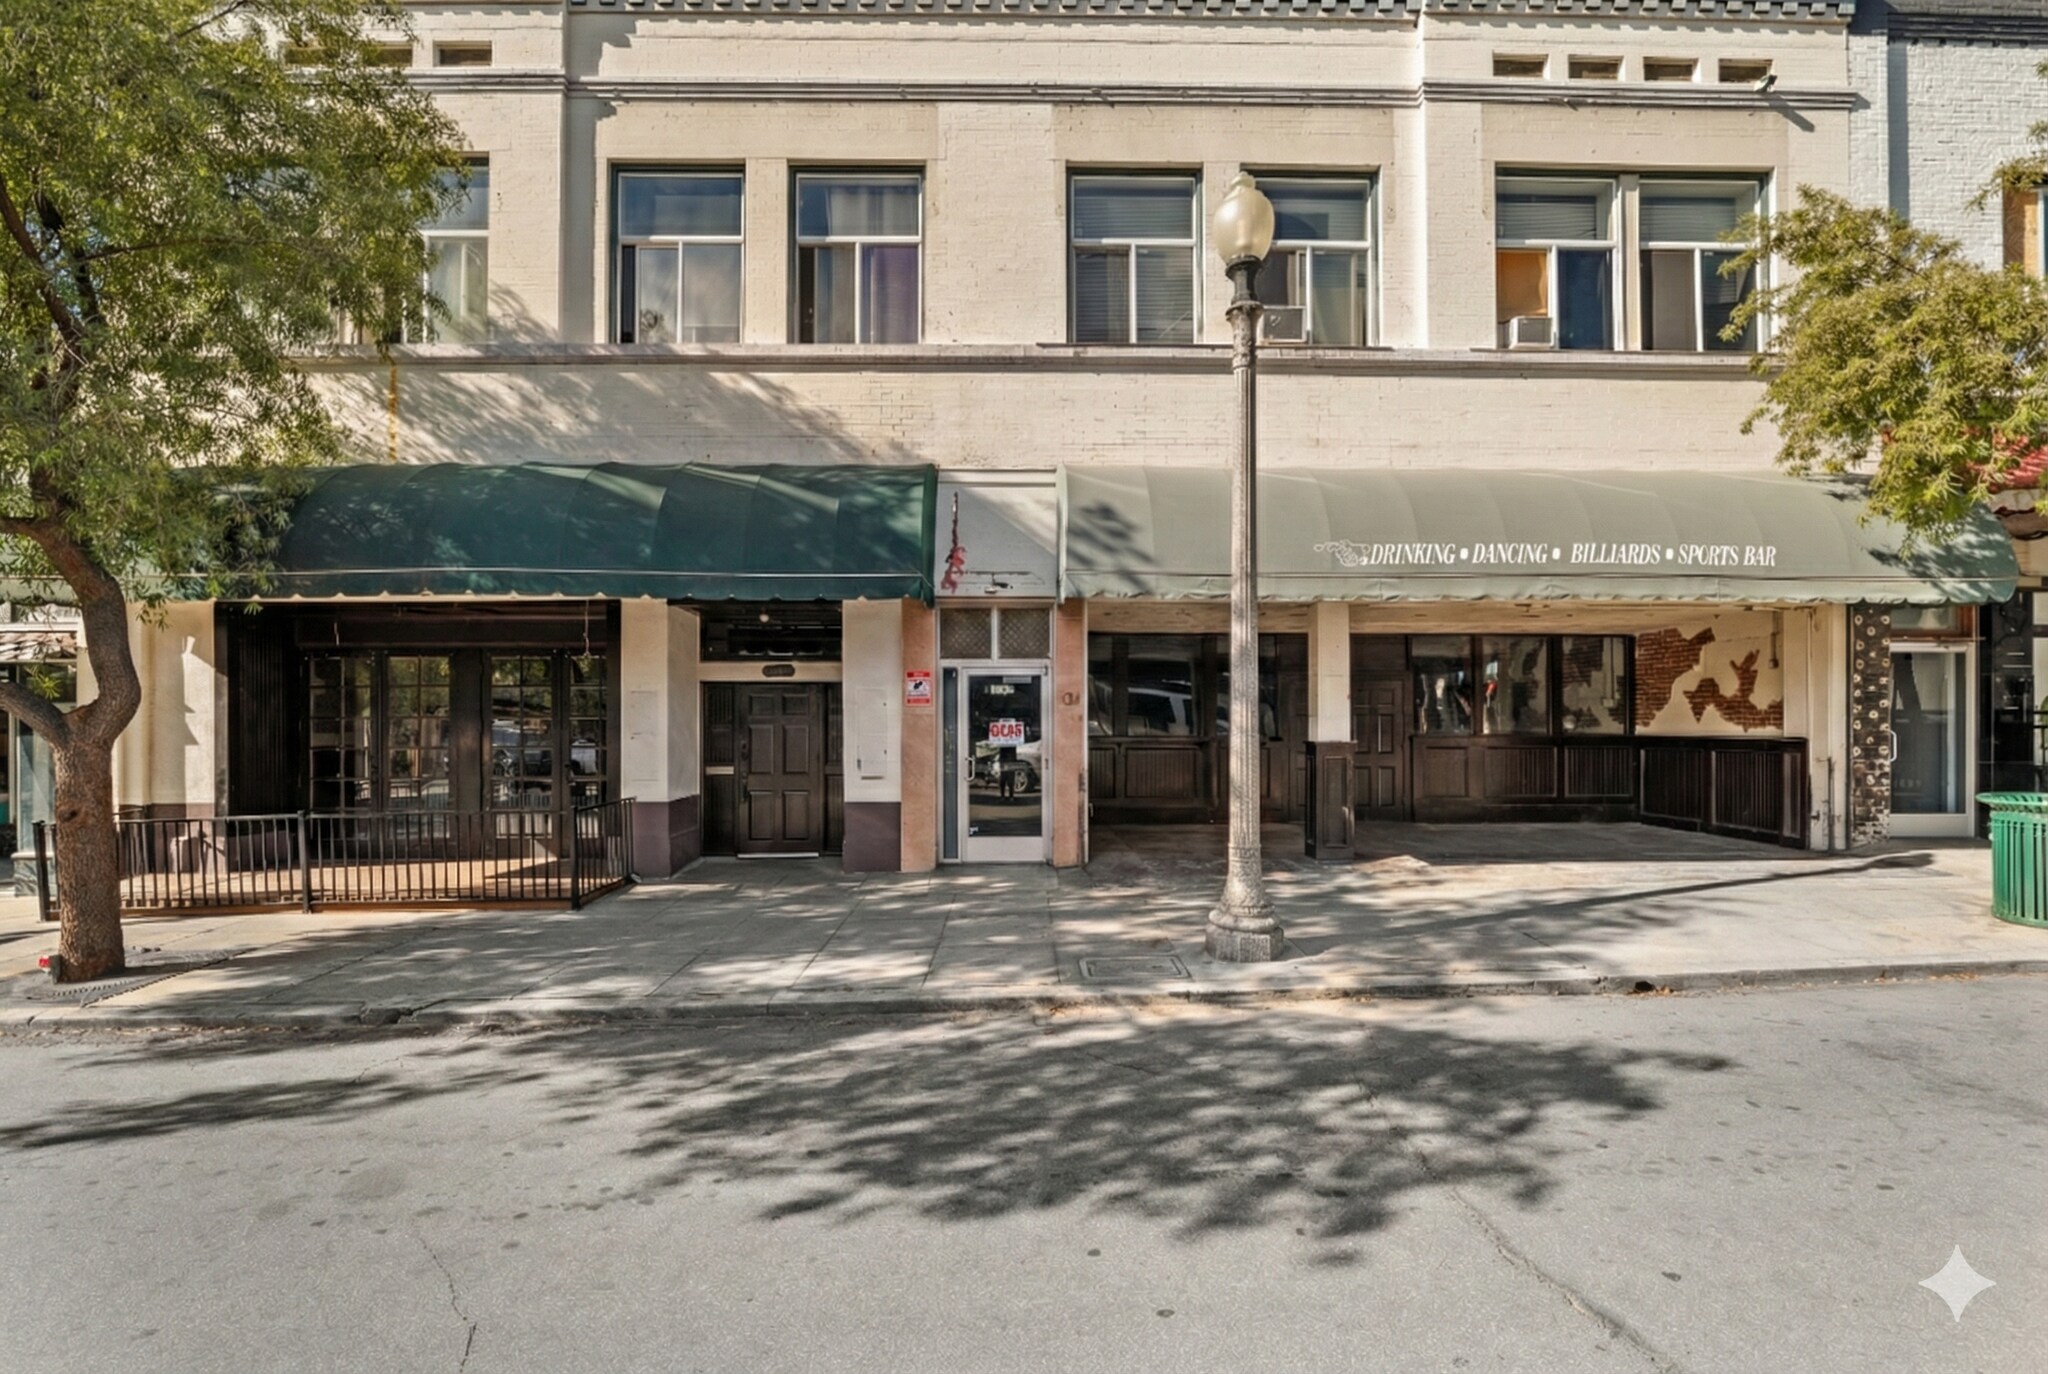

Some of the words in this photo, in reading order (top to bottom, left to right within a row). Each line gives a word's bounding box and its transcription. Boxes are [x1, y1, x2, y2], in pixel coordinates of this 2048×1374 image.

[1370, 543, 1456, 565] DRINKING
[1472, 543, 1548, 565] DANCING
[1570, 543, 1661, 565] BILLIARDS
[1678, 543, 1739, 566] SPORTS
[1743, 545, 1777, 567] BAR
